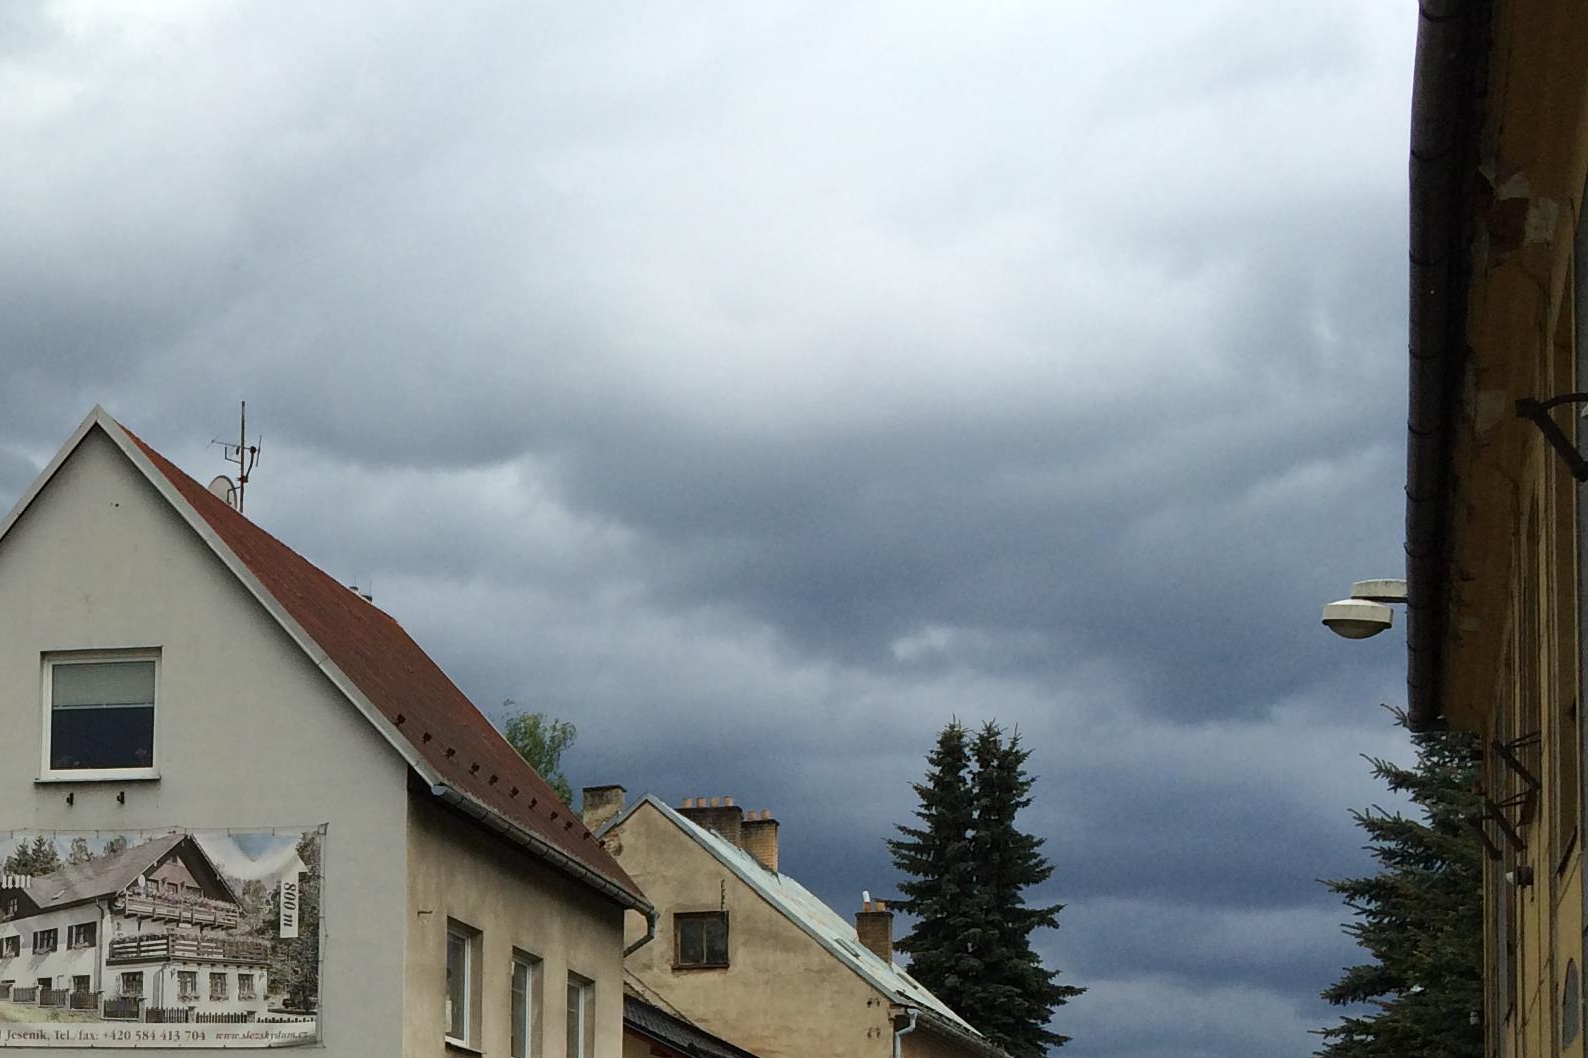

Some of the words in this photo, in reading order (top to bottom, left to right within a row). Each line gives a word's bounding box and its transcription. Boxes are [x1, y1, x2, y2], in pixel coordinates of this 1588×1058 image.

[283, 882, 297, 911] 800
[283, 913, 293, 928] m
[103, 1029, 131, 1041] +420
[135, 1030, 156, 1041] 584
[160, 1030, 181, 1041] 413
[185, 1030, 206, 1041] 704
